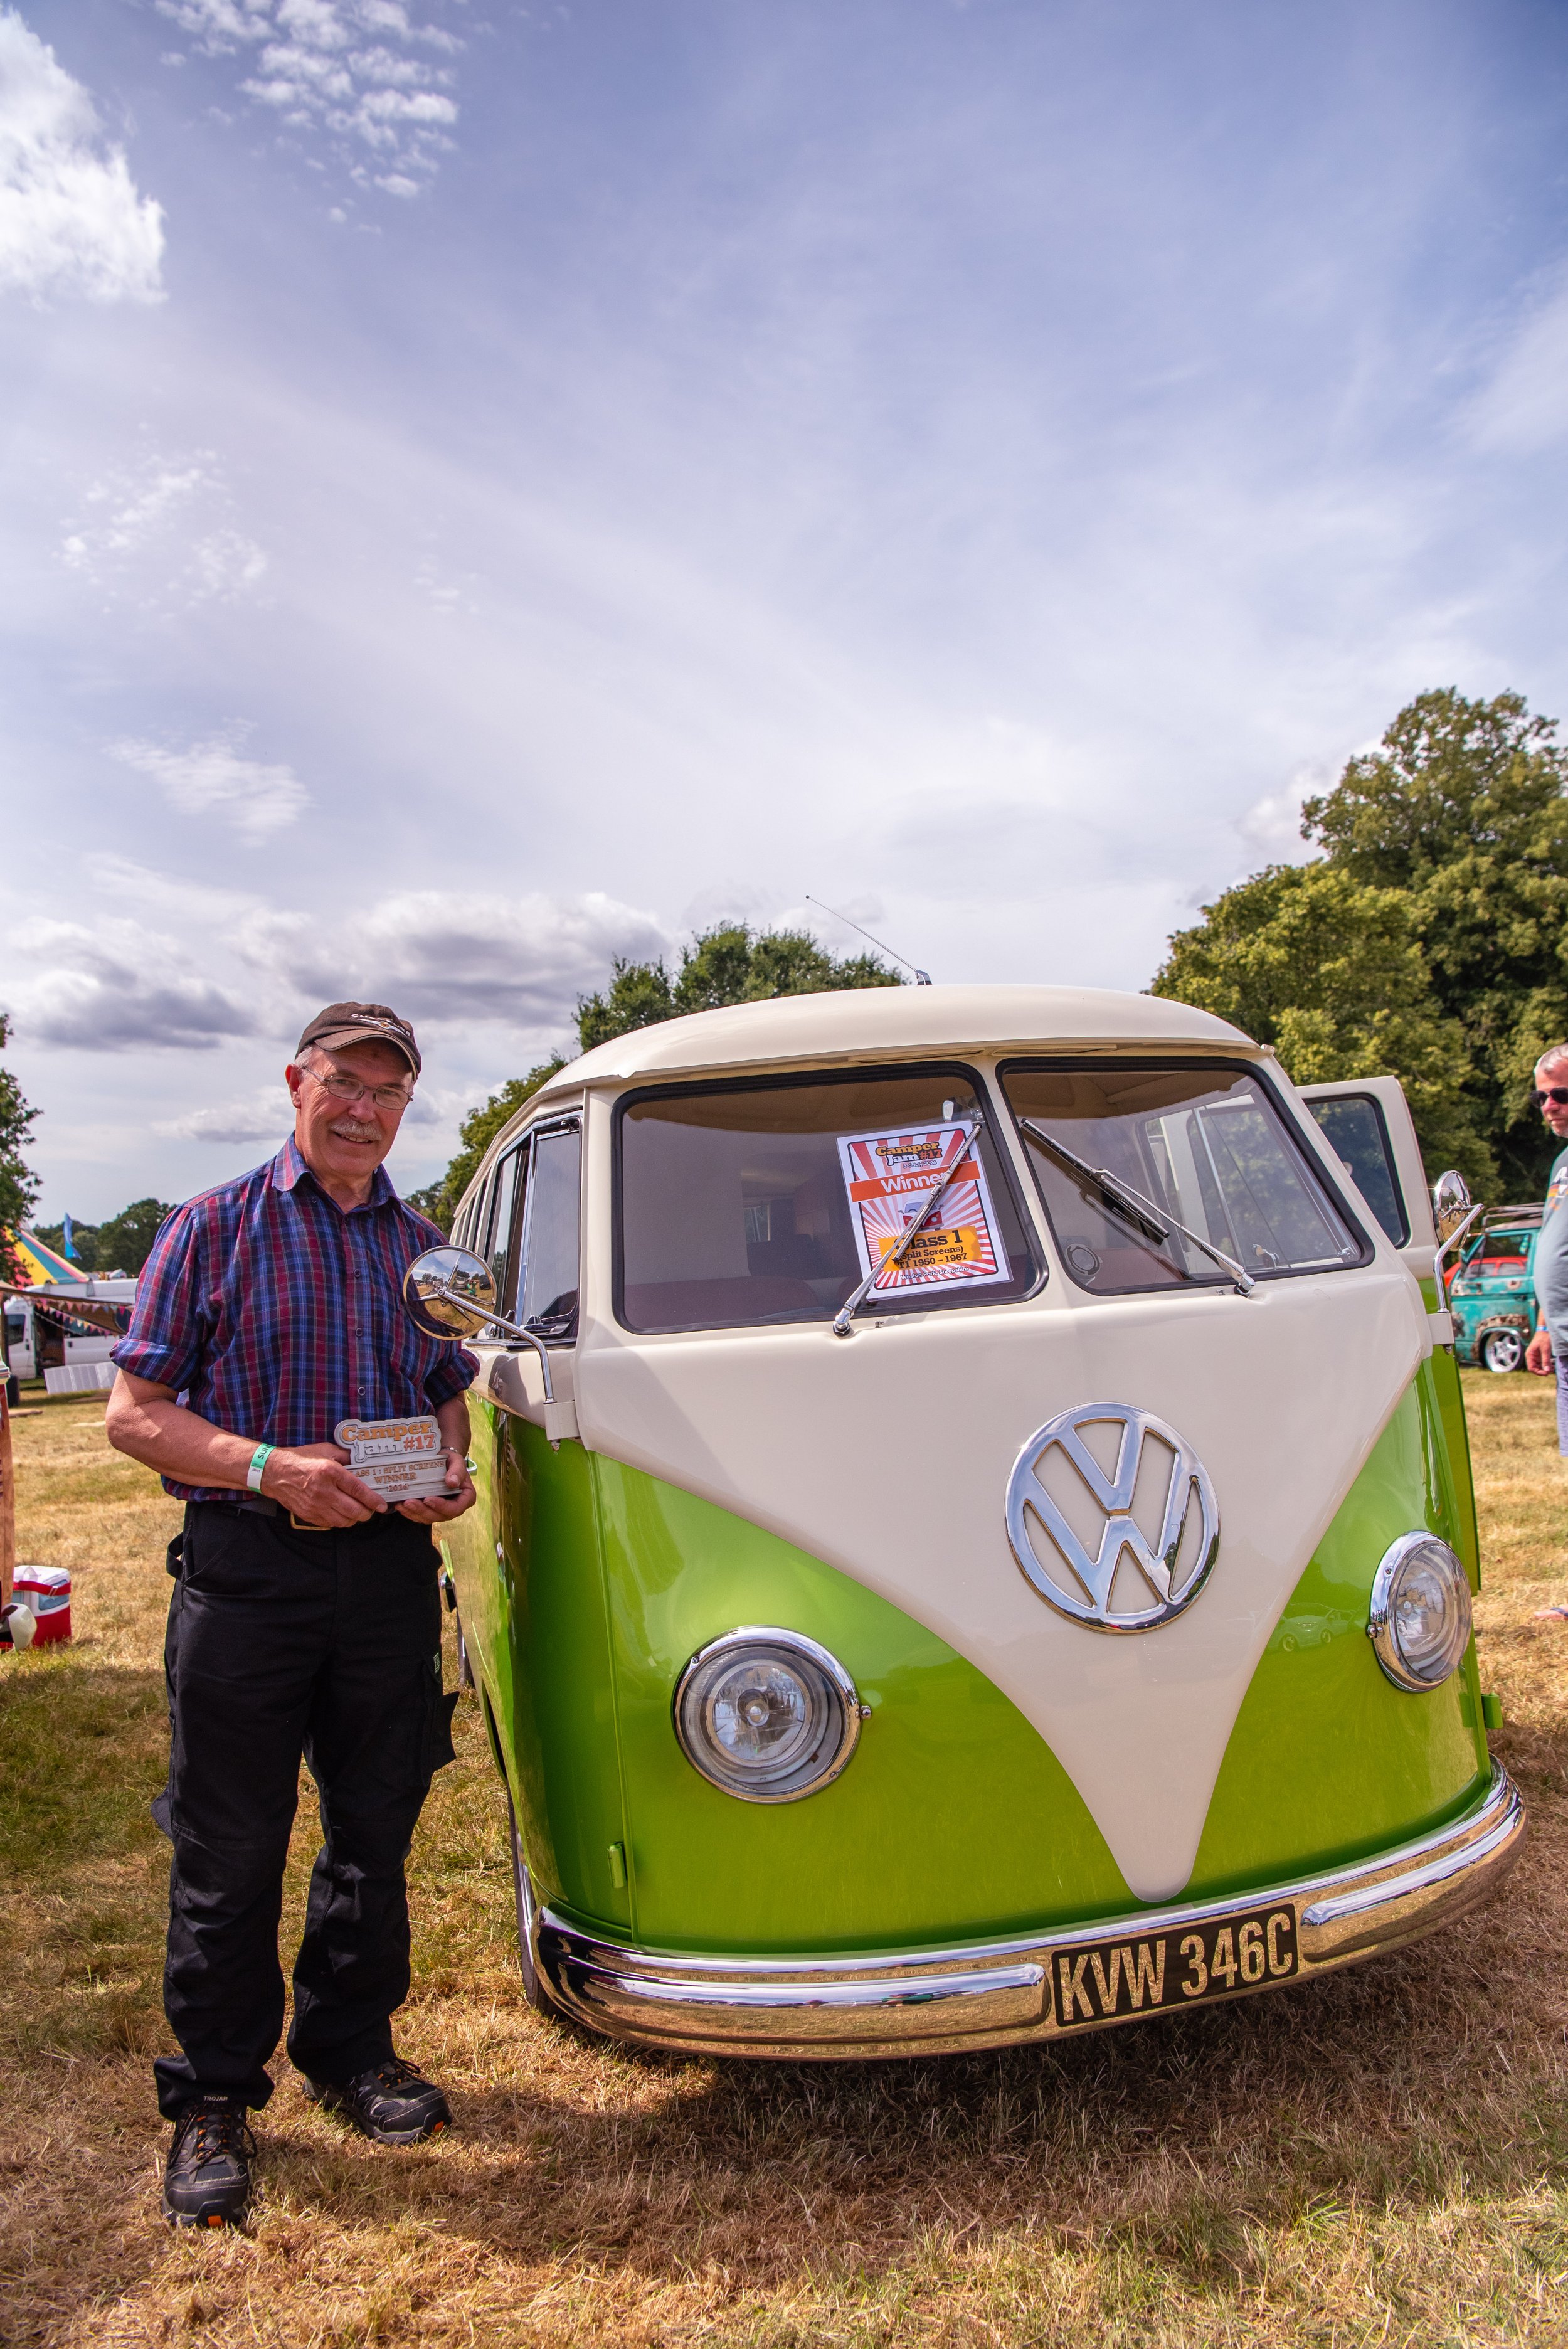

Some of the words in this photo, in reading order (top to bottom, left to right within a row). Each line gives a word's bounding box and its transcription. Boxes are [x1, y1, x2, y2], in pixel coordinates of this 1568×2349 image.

[876, 1142, 939, 1156] Camper
[887, 1154, 919, 1165] Jam
[919, 1149, 942, 1160] #17
[952, 1230, 963, 1243] 1
[923, 1245, 963, 1256] Screens)
[898, 1261, 910, 1269] T1
[913, 1258, 935, 1266] 1950
[945, 1253, 967, 1262] 1967
[939, 1266, 969, 1275] Shropshire
[342, 1421, 433, 1441] Camper
[358, 1441, 402, 1460] Jam
[403, 1434, 435, 1451] #17
[349, 1469, 370, 1477] ASS
[384, 1465, 406, 1474] SPLIT
[408, 1460, 445, 1471] SCREENS
[374, 1472, 417, 1483] WINNER
[388, 1483, 408, 1492] 2026
[1059, 1940, 1166, 2021] KVW
[1180, 1912, 1294, 1996] 346C
